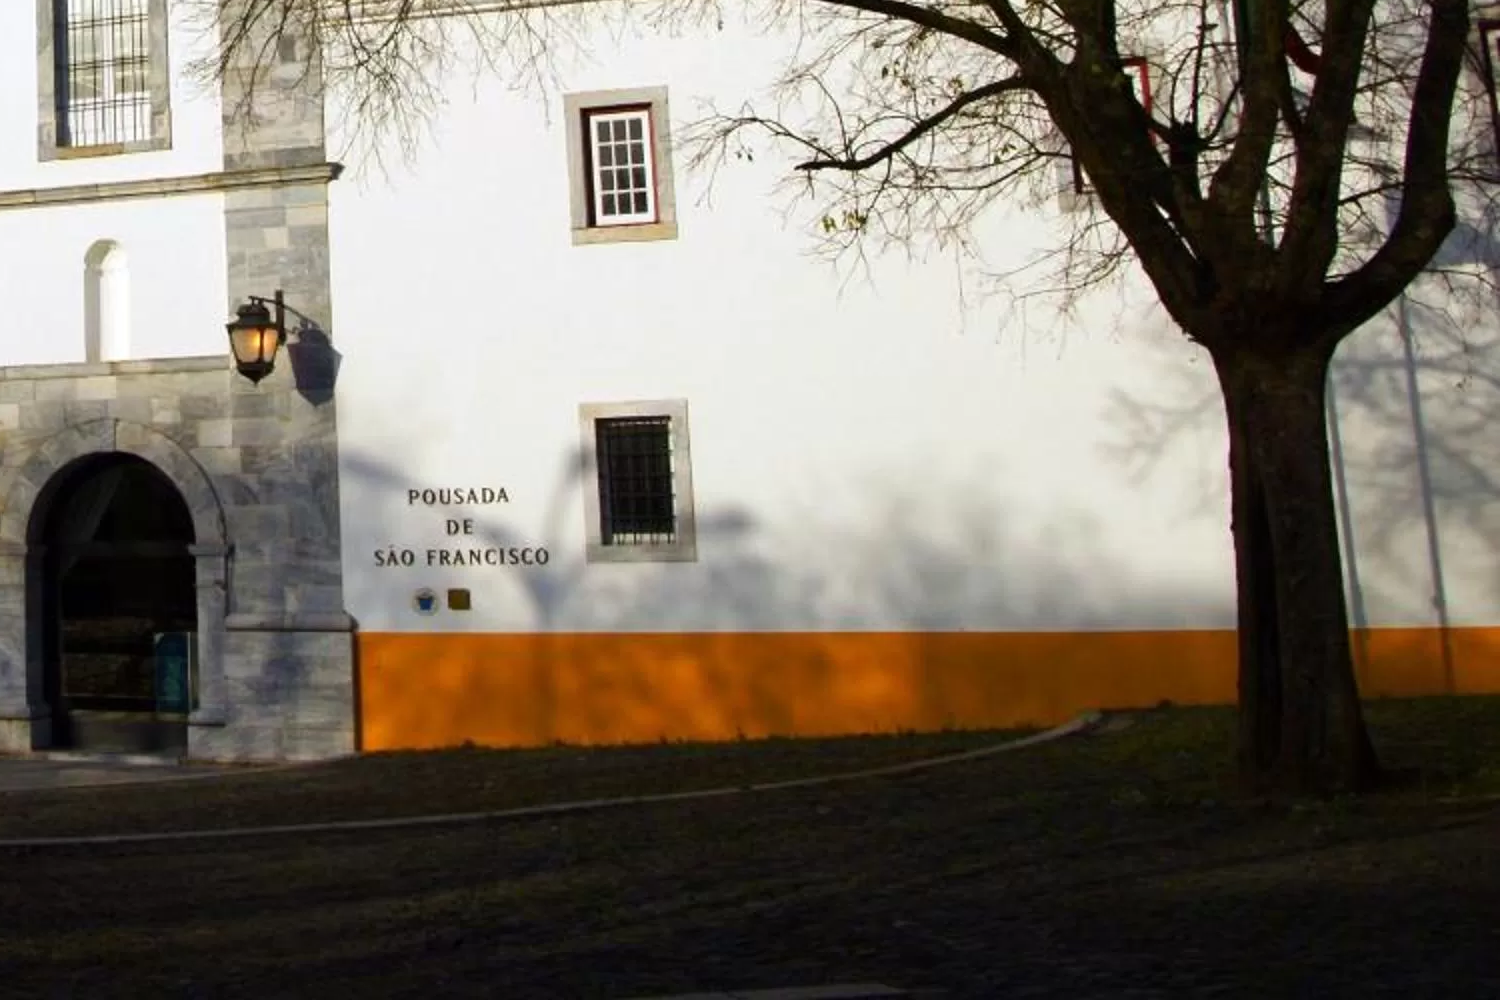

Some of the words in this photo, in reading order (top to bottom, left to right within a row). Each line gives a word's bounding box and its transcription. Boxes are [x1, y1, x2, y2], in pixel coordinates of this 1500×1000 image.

[408, 488, 509, 505] POUSADA
[446, 519, 474, 535] DE
[427, 547, 549, 566] FRANCISCO
